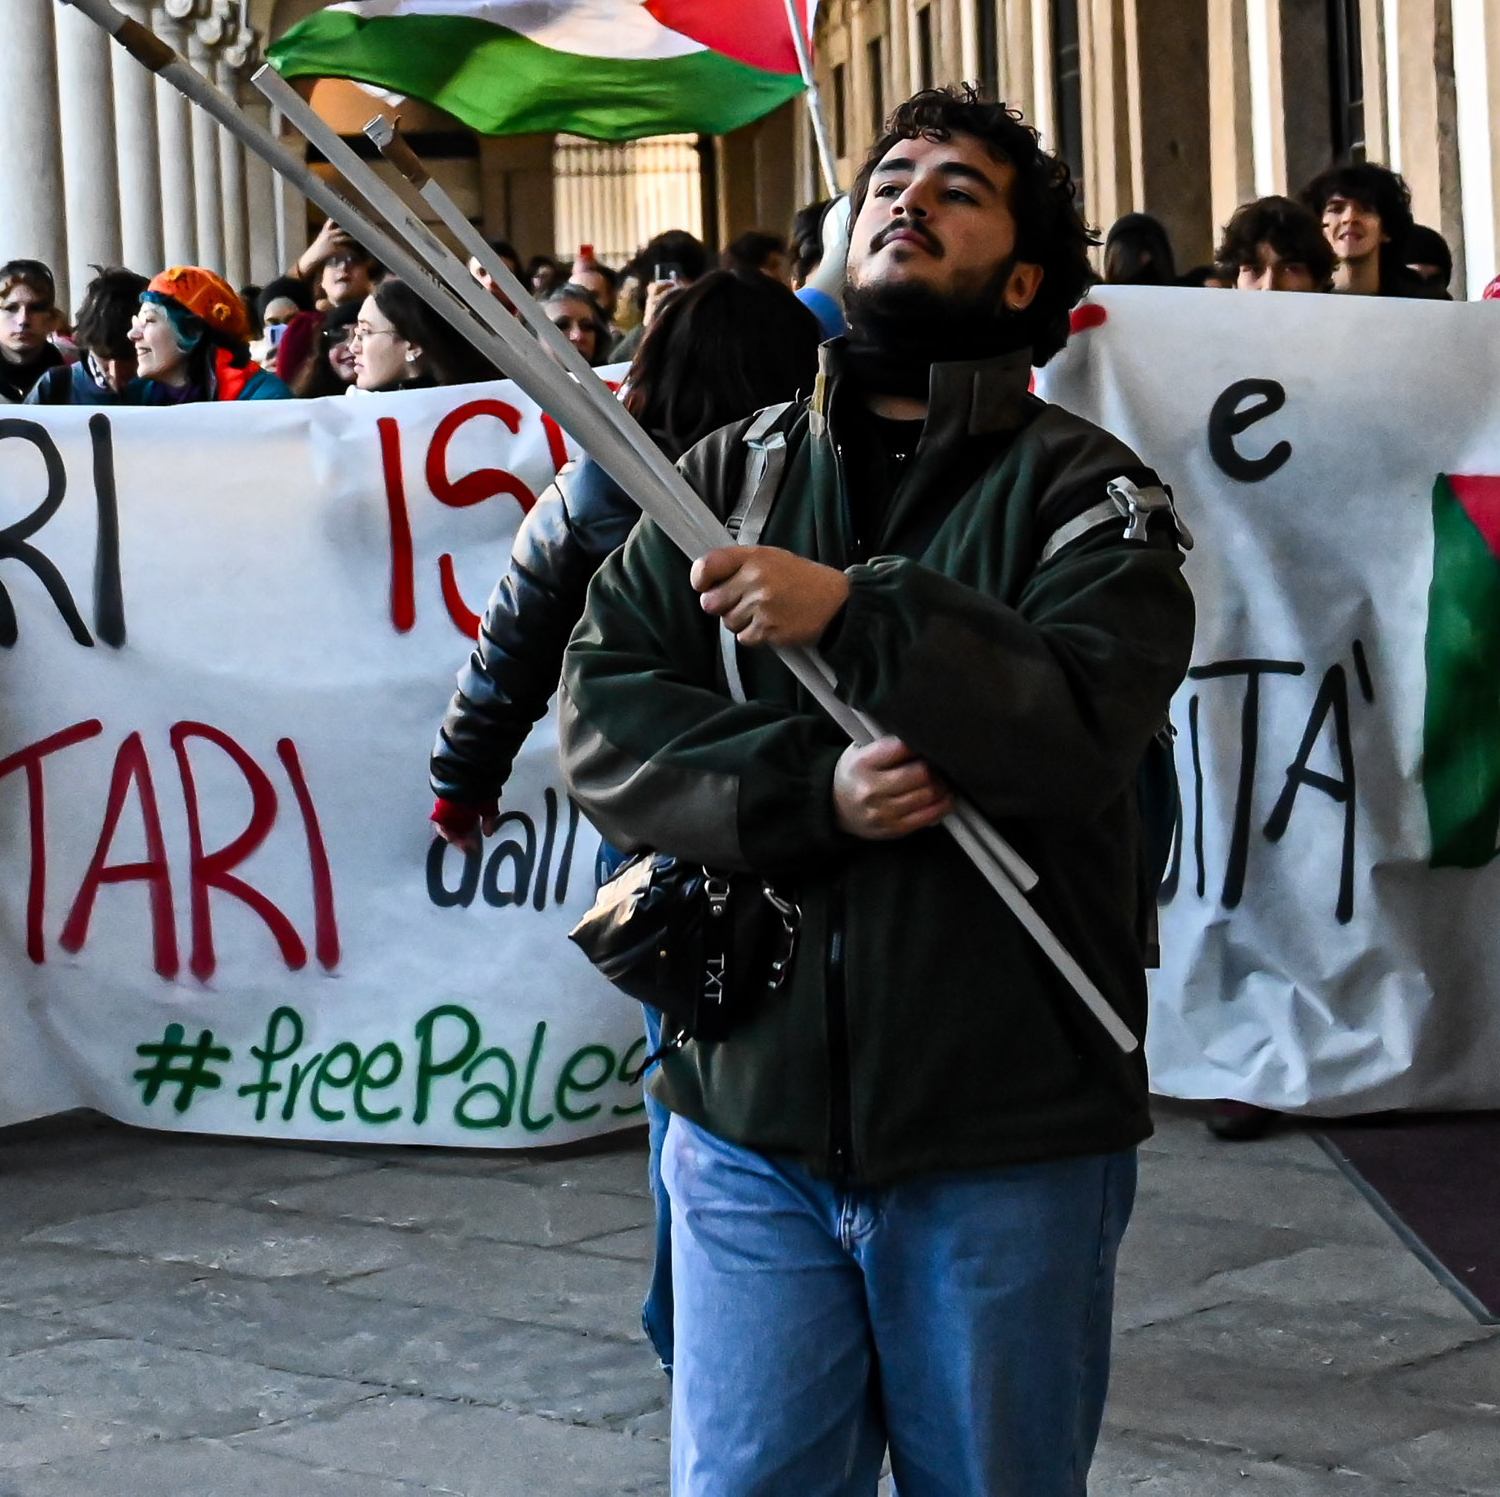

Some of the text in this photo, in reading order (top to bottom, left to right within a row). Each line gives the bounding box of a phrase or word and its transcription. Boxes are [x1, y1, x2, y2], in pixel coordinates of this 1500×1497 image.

[376, 398, 568, 641] IS
[1208, 378, 1292, 482] e
[1157, 638, 1373, 925] ITA'
[703, 952, 726, 1005] TXT
